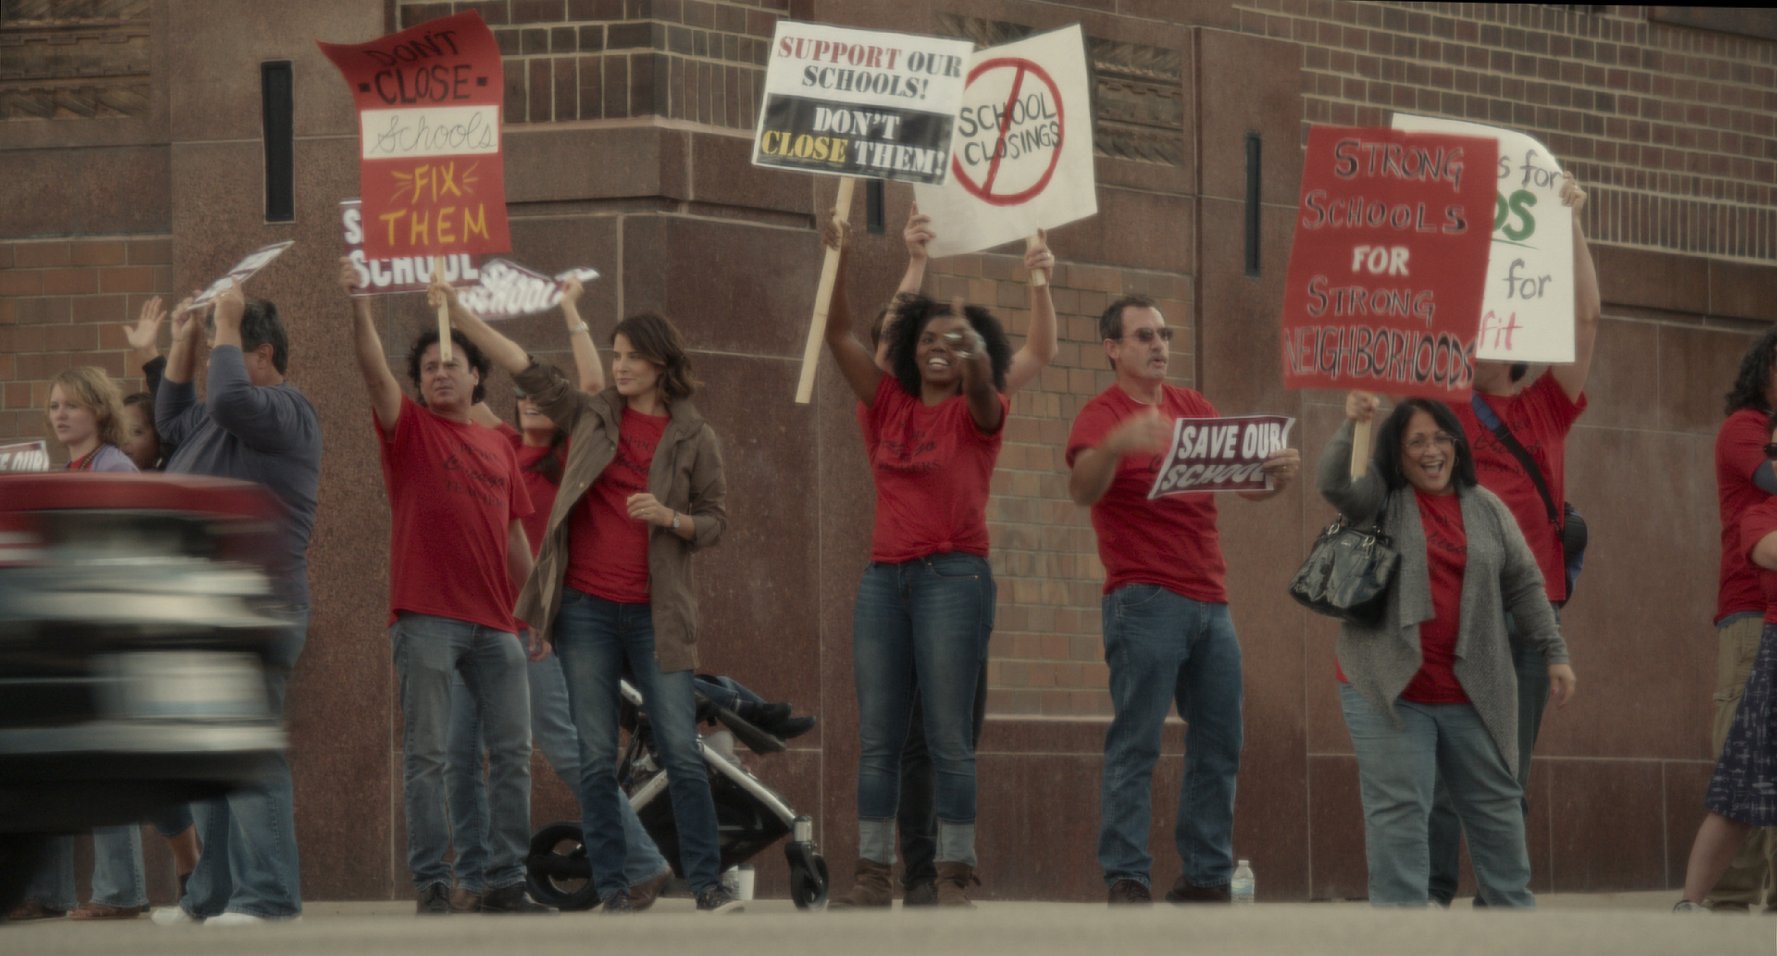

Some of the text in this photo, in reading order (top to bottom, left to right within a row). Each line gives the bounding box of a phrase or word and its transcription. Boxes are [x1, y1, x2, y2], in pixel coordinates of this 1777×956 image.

[778, 35, 962, 78] SUPPORT OUR
[374, 64, 472, 105] CLOSE
[801, 65, 930, 100] SCHOOLS!
[371, 111, 497, 154] Schools
[812, 106, 901, 140] DON'T
[957, 91, 1058, 138] SCHOOL
[762, 130, 945, 177] CLOSE THEM!
[964, 122, 1061, 166] CLOSINGS
[1333, 138, 1465, 193] STRONG
[412, 161, 461, 205] FIX
[1519, 148, 1562, 188] for
[379, 203, 489, 246] THEM
[1303, 189, 1469, 234] SCHOOLS
[1351, 245, 1411, 277] FOR
[1502, 257, 1552, 301] for
[1306, 274, 1435, 328] STRONG
[1284, 323, 1477, 389] NEIGHBORHOODS
[1178, 422, 1281, 459] SAVE OUR
[1160, 462, 1265, 491] SCHOOL
